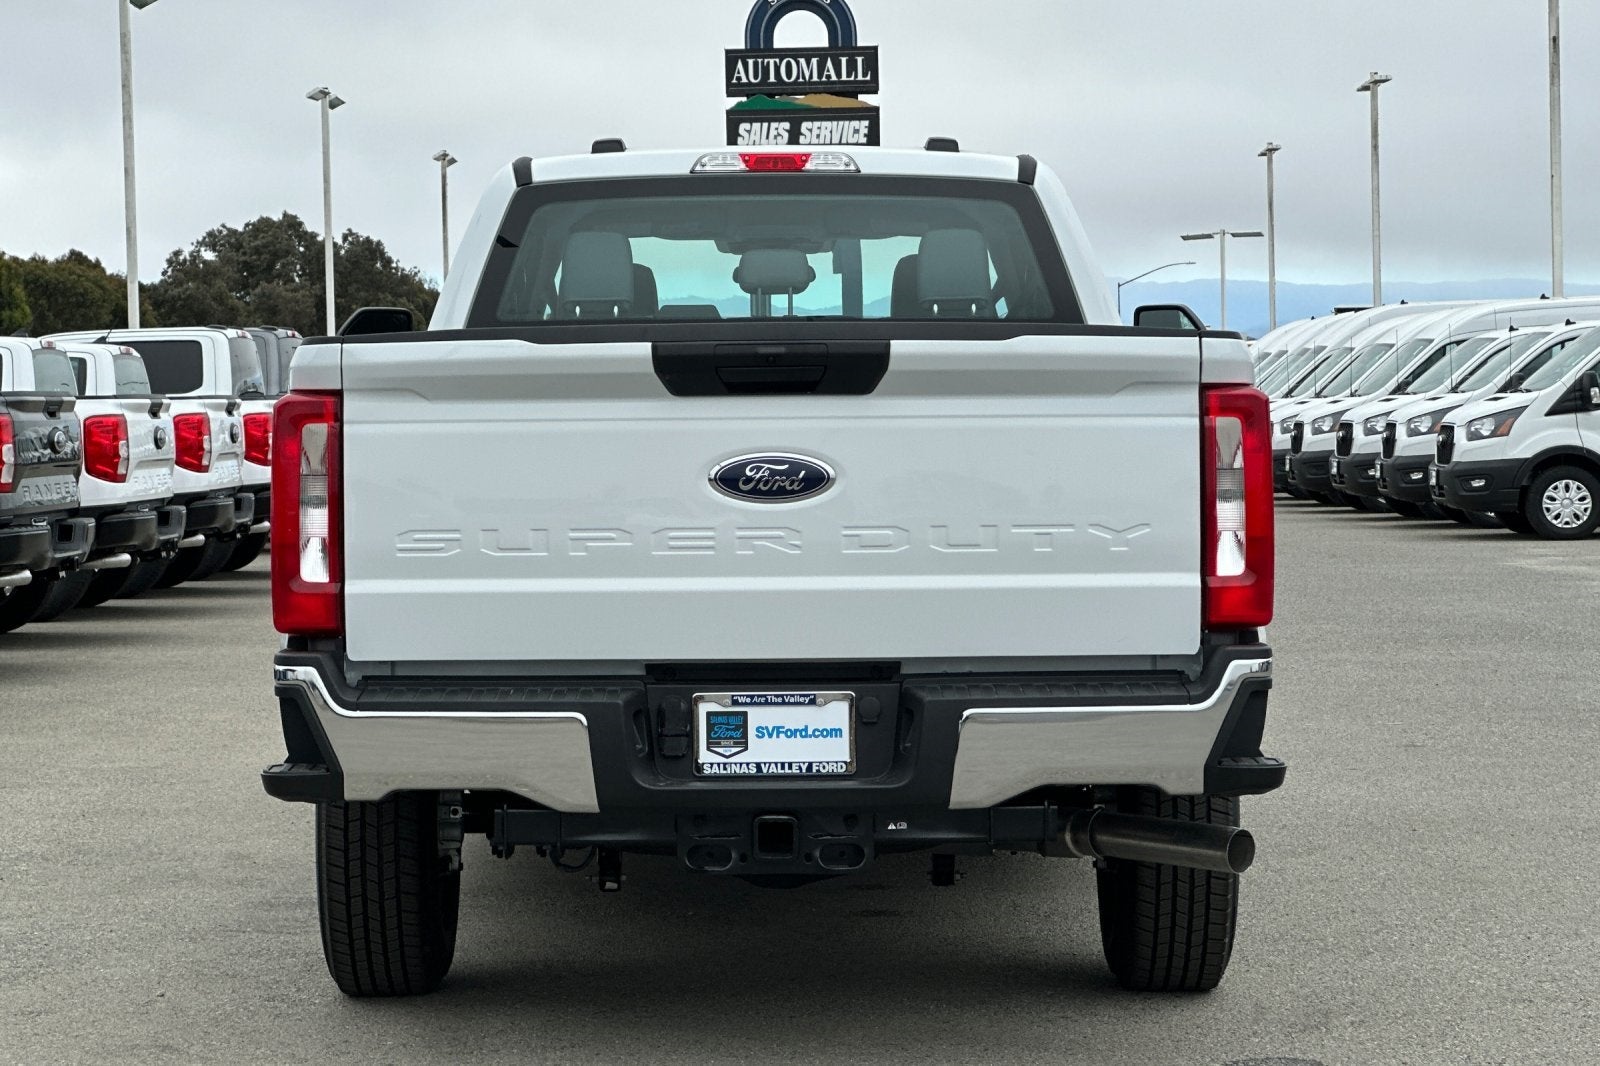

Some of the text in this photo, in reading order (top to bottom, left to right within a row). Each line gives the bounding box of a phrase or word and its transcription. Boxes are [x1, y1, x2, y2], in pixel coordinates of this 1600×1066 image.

[731, 56, 871, 83] AUTOMALL
[737, 120, 870, 145] SALES SERVICE
[738, 463, 806, 491] Ford
[396, 523, 1152, 556] SUPER DUTY
[766, 695, 782, 703] The
[711, 724, 743, 738] Ford
[755, 725, 843, 739] SVFord.com
[703, 762, 847, 774] SALINAS VALLEY FORD
